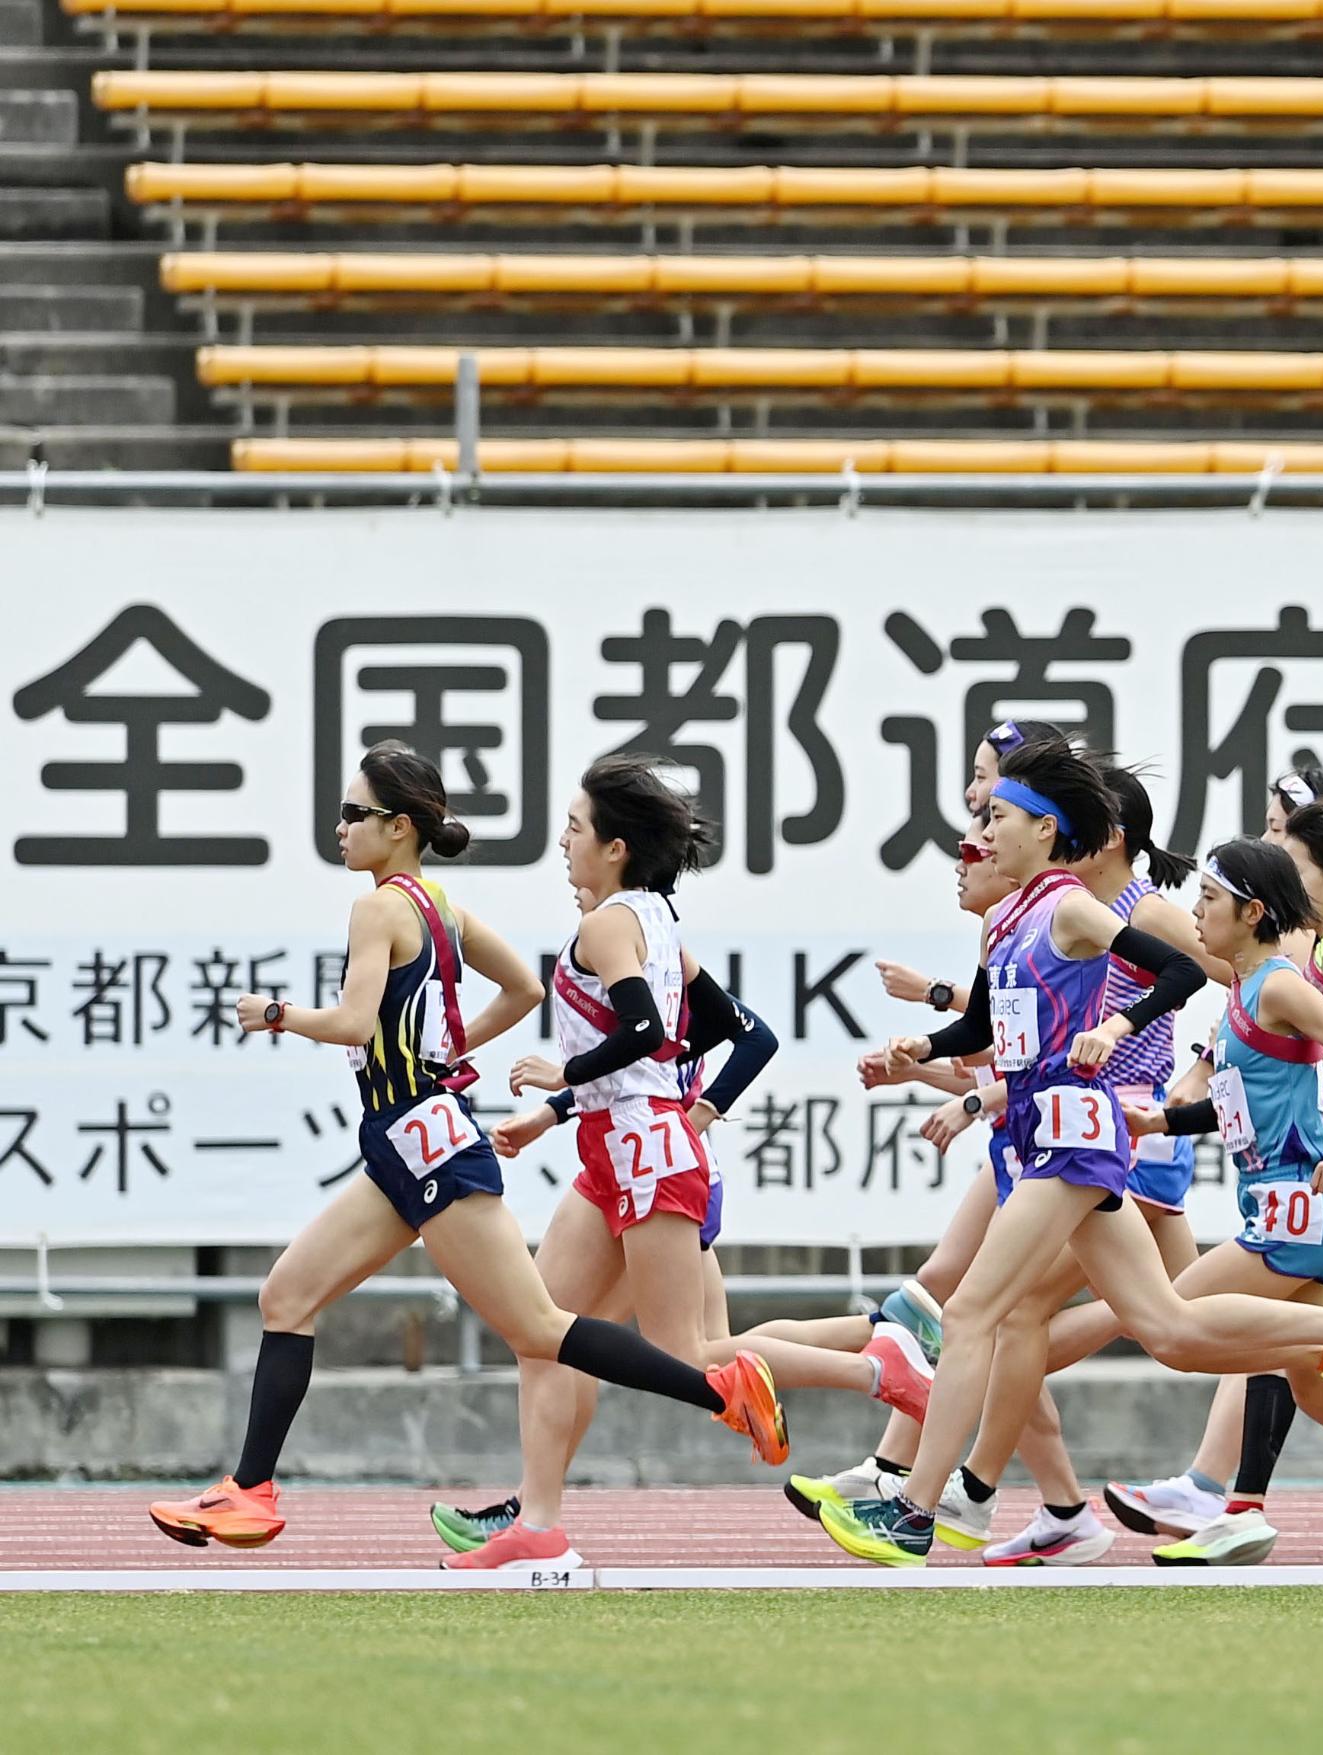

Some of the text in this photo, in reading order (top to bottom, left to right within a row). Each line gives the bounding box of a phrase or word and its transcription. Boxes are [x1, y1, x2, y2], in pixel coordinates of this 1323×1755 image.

[994, 1020, 1027, 1056] 3-1
[404, 1103, 468, 1165] 22
[1051, 1093, 1101, 1141] 13
[1218, 1104, 1243, 1140] 0-1
[620, 1121, 674, 1179] 27
[1263, 1189, 1311, 1236] 40
[531, 1571, 571, 1587] B-34
